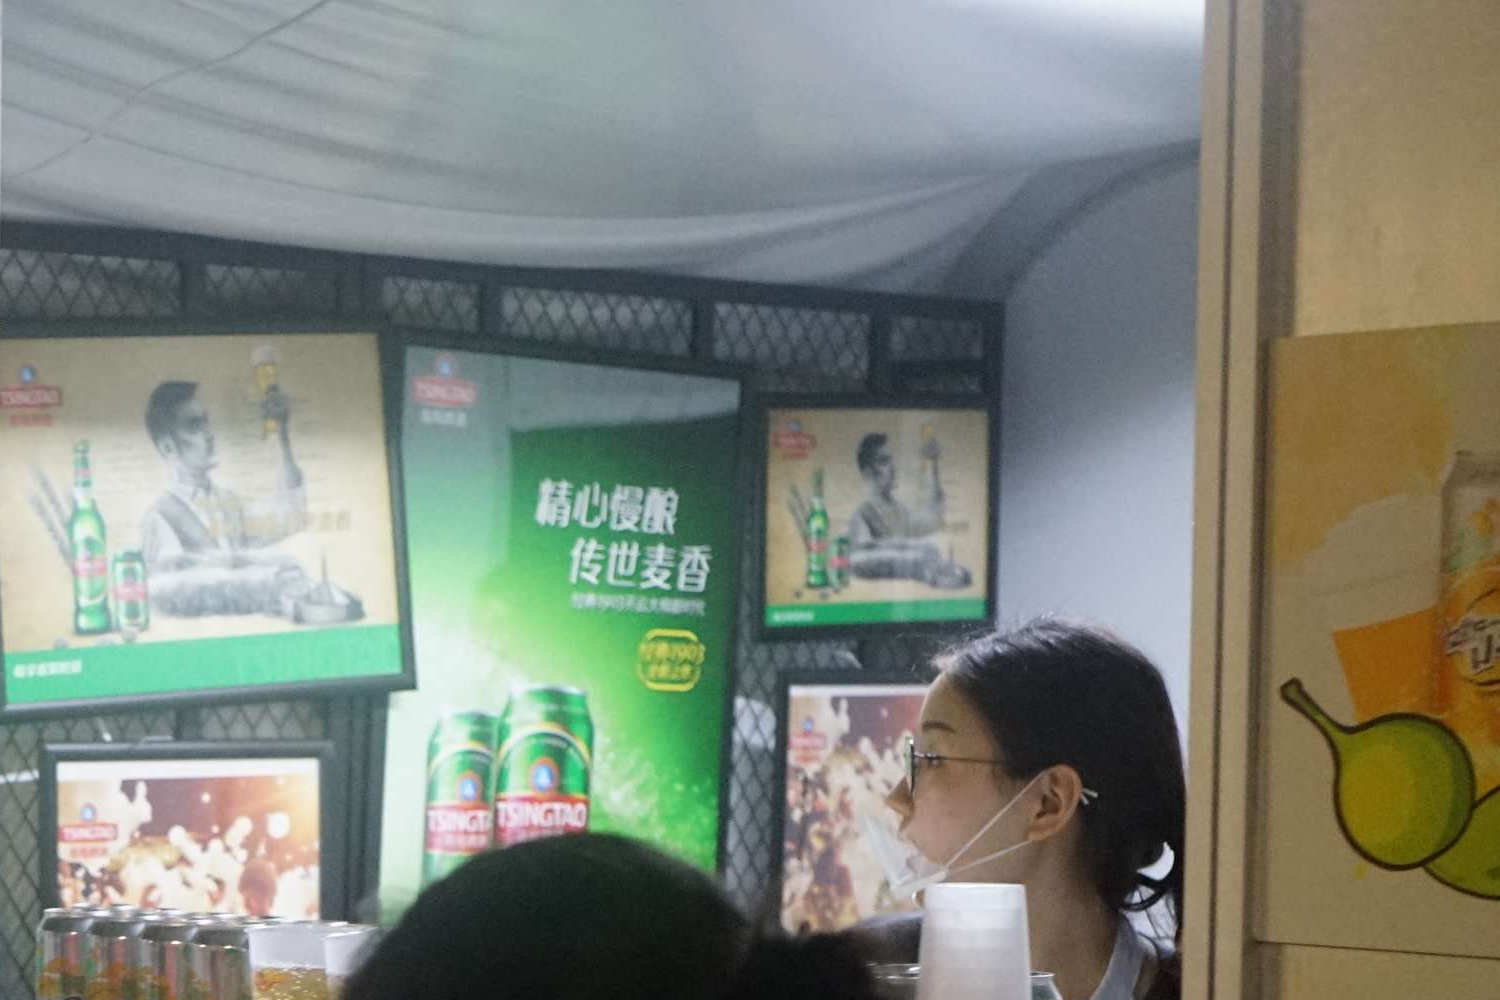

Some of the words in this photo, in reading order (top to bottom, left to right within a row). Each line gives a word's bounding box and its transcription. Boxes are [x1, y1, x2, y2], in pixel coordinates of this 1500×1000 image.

[535, 477, 679, 535] 精心慢酿
[569, 537, 713, 592] 传世麦香
[498, 801, 587, 828] TSINGTAO
